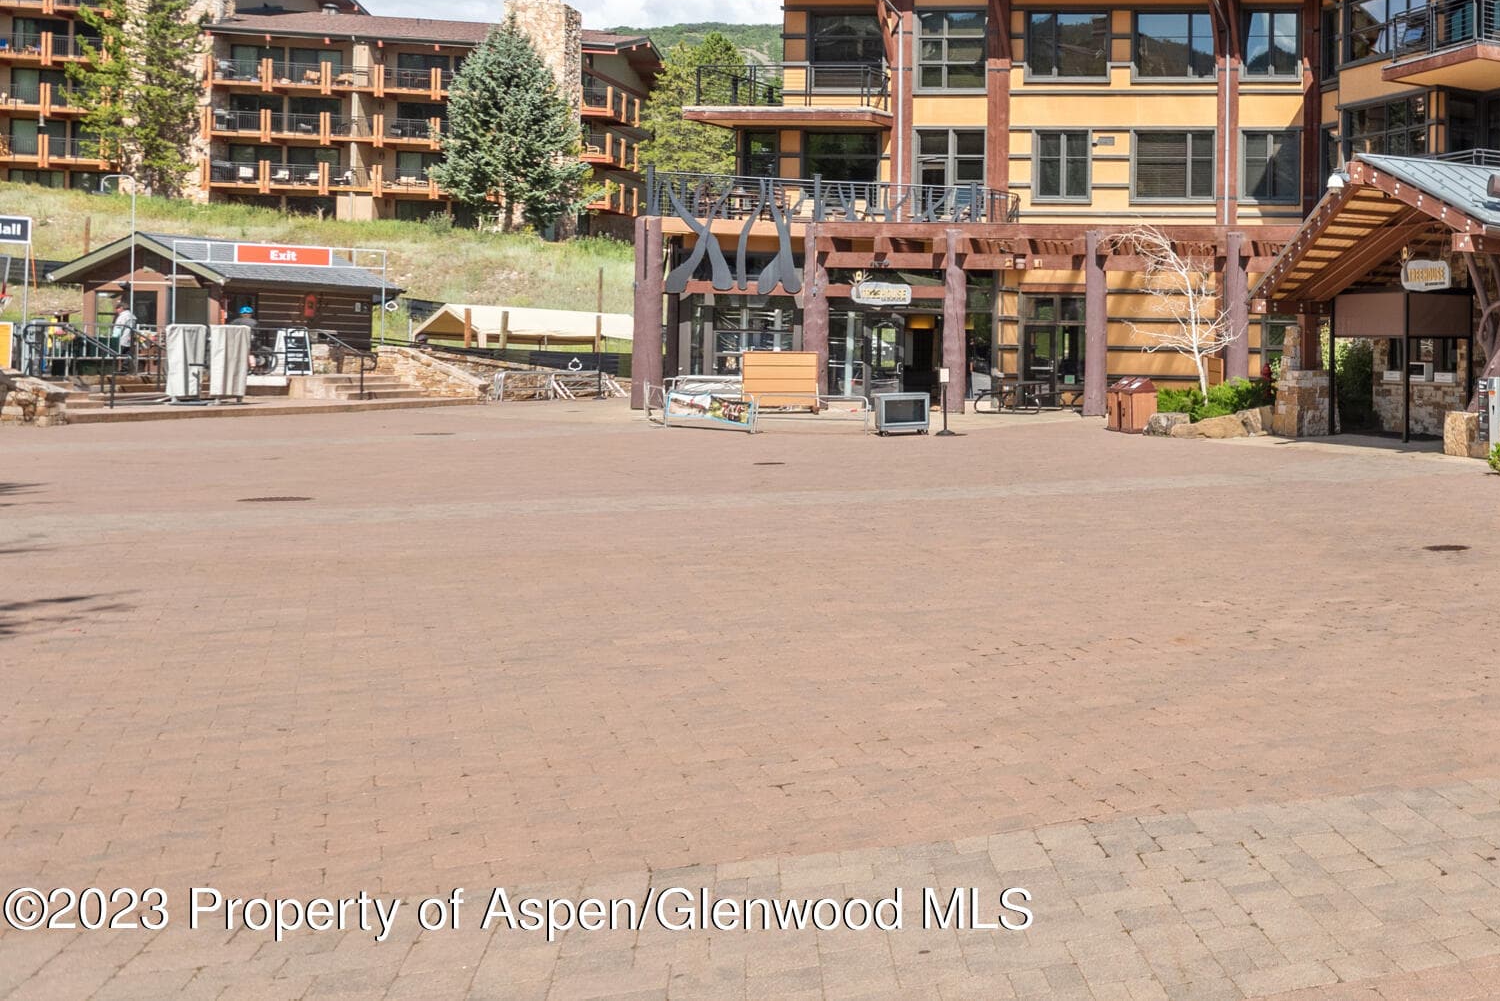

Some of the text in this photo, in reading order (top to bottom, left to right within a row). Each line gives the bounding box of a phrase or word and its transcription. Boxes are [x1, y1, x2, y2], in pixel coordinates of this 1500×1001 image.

[0, 223, 22, 236] all
[269, 250, 297, 261] Exit
[1408, 267, 1446, 283] TREEHOUSE
